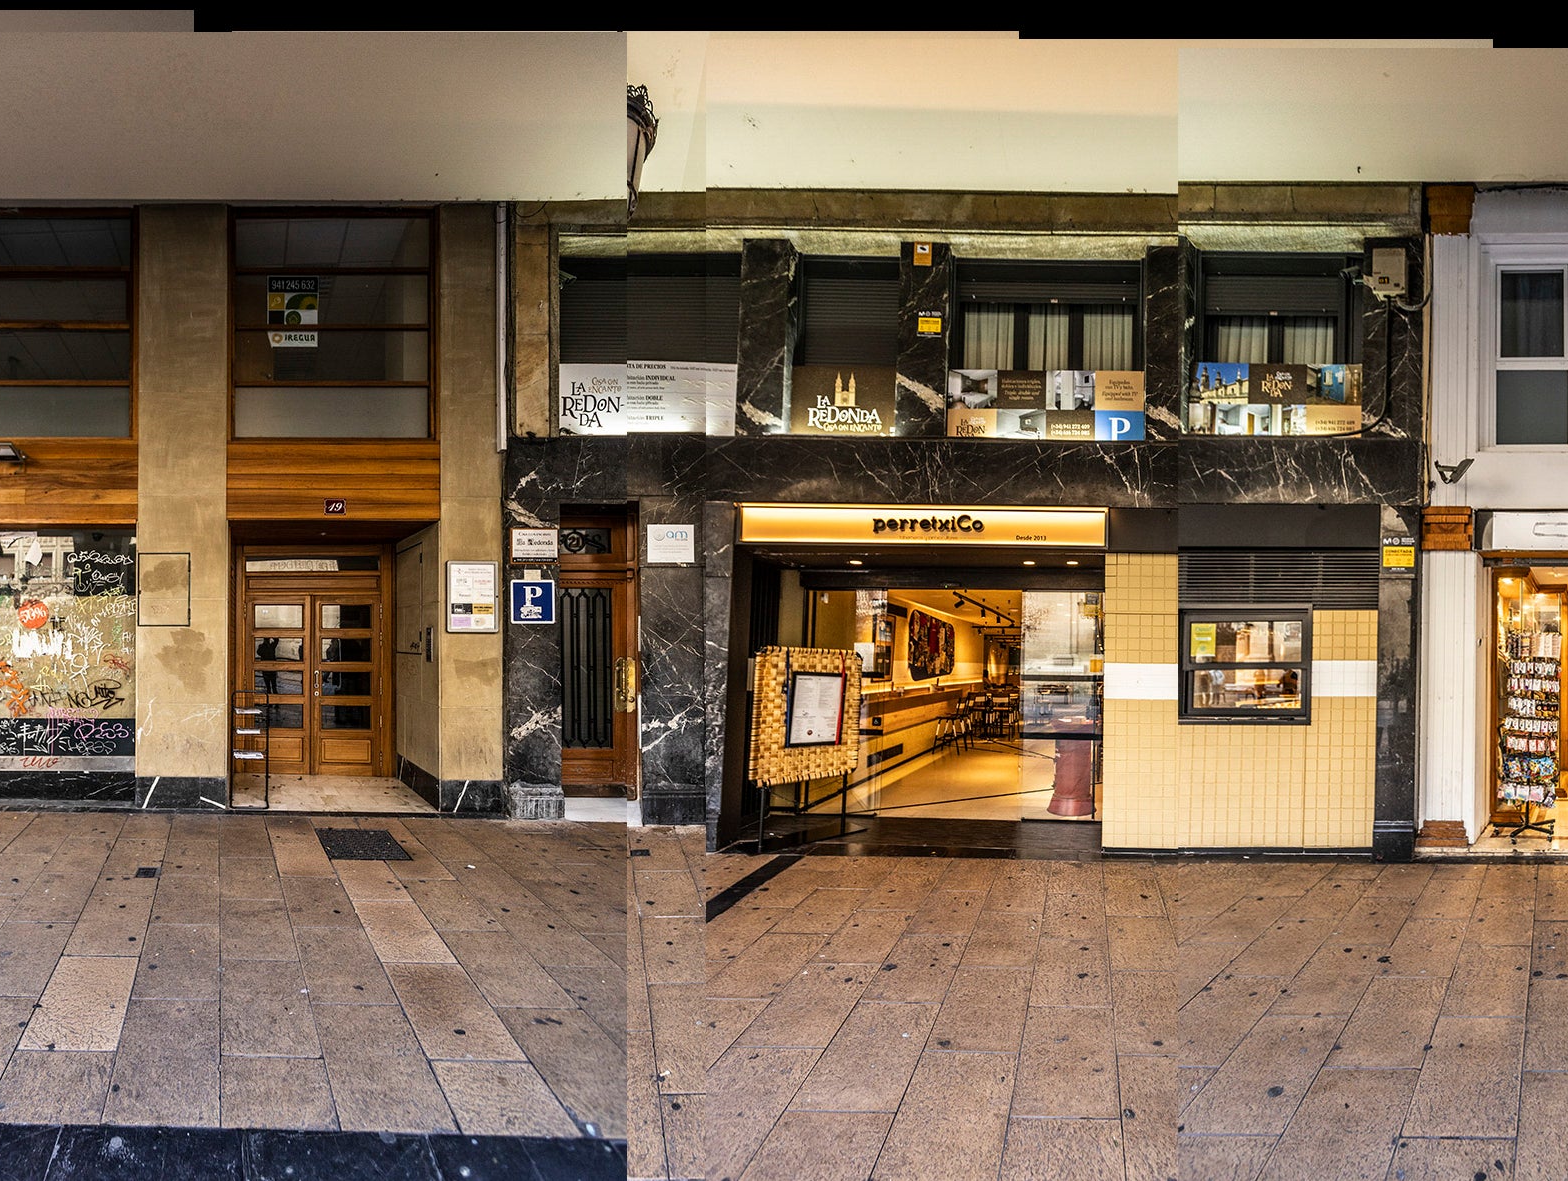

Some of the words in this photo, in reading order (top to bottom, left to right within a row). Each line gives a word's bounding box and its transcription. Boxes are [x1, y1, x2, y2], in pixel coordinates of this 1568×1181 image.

[271, 279, 285, 290] 941
[285, 279, 300, 290] 245
[571, 381, 587, 396] LA
[816, 394, 831, 408] LA
[1108, 417, 1131, 441] P
[328, 502, 343, 512] 19
[872, 514, 985, 533] perretxiCo
[522, 585, 543, 606] P
